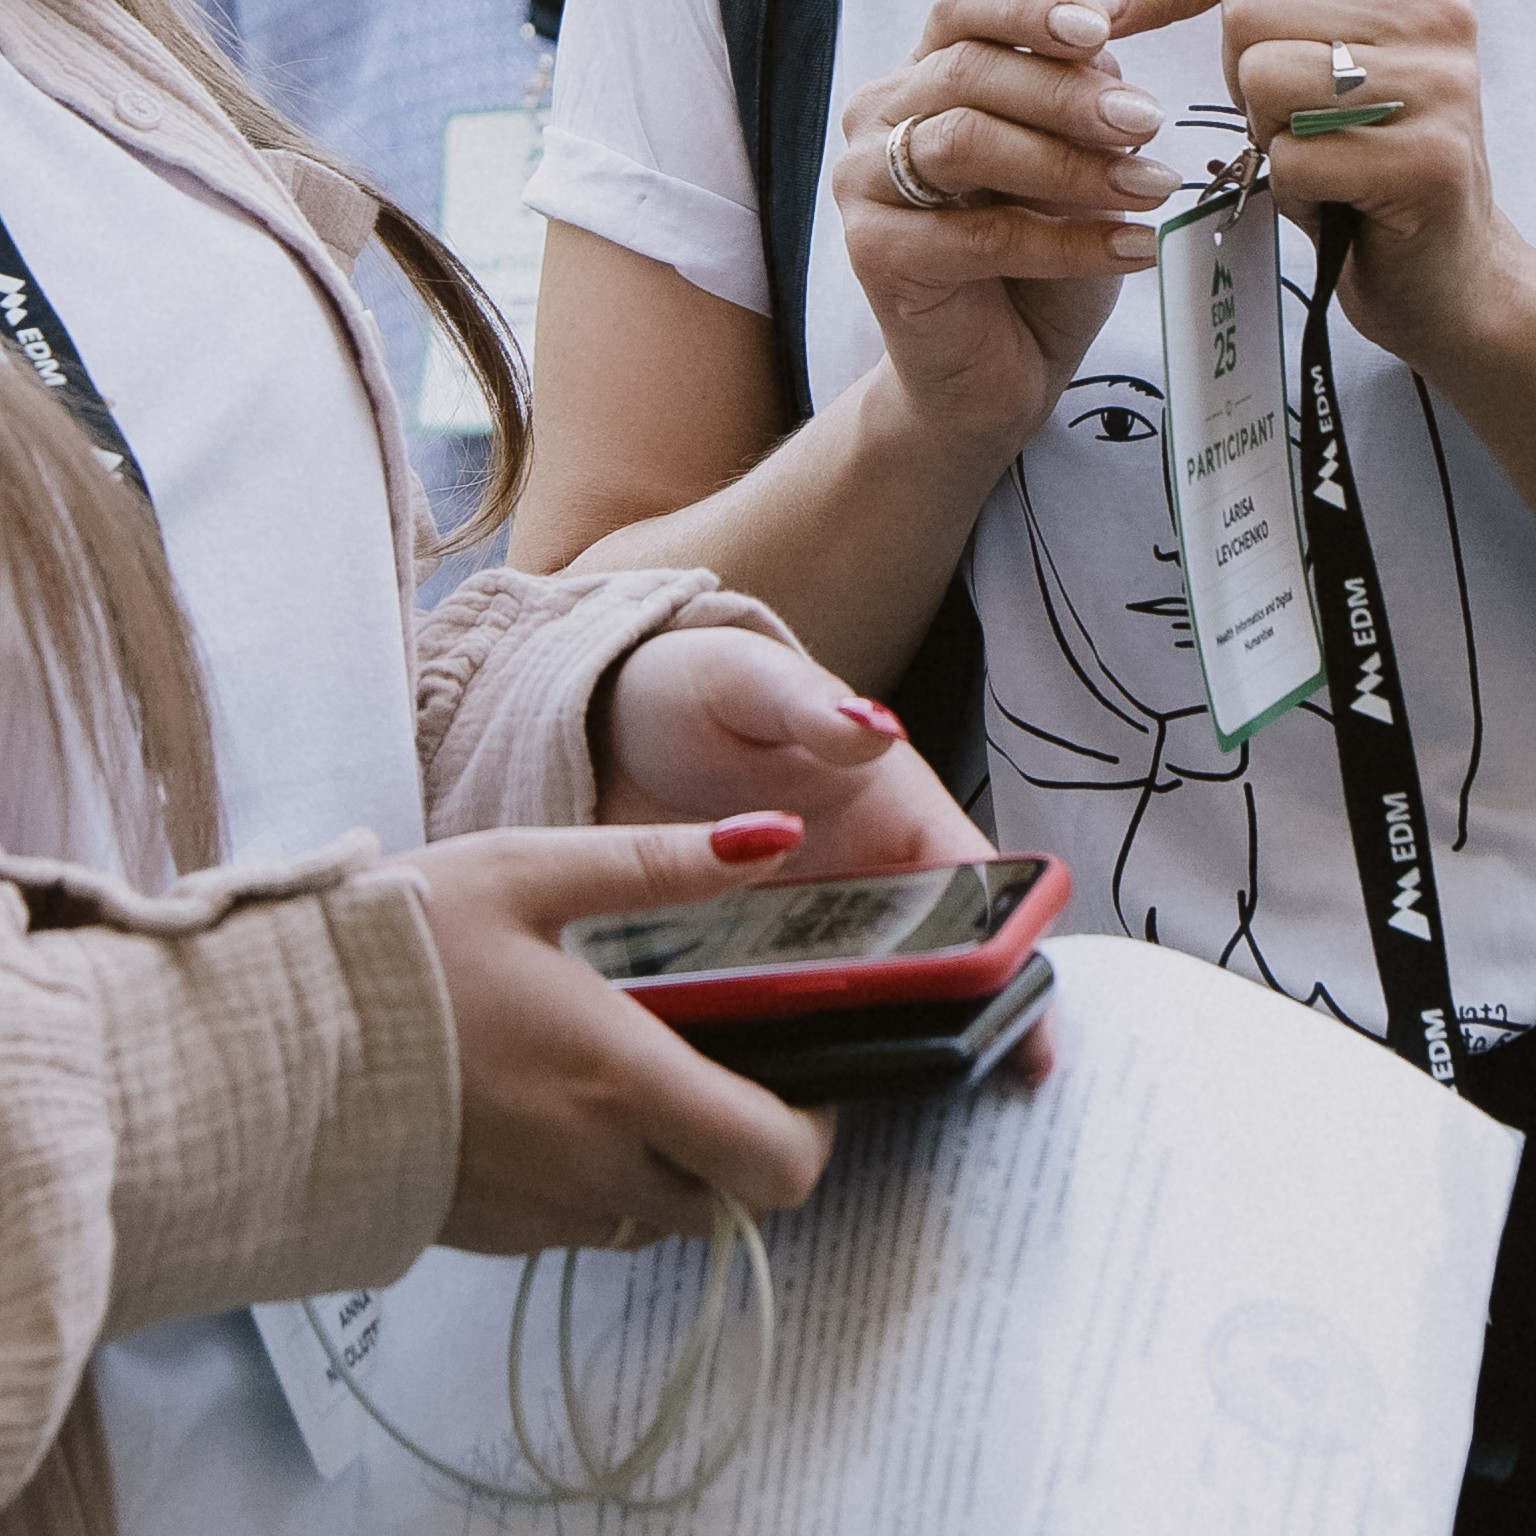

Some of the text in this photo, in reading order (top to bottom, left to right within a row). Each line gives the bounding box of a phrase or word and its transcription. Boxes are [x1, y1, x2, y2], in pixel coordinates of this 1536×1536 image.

[1211, 296, 1236, 327] EDM
[16, 327, 67, 387] EDM
[1214, 325, 1237, 379] 25
[1310, 365, 1334, 434] EDM
[1186, 412, 1275, 485] PARTICIPANT
[1216, 520, 1269, 567] LEVCHENKO
[1222, 496, 1255, 529] LARISA
[1344, 576, 1377, 647] EDM
[1382, 792, 1417, 863] EDM
[1421, 1008, 1455, 1081] EDM
